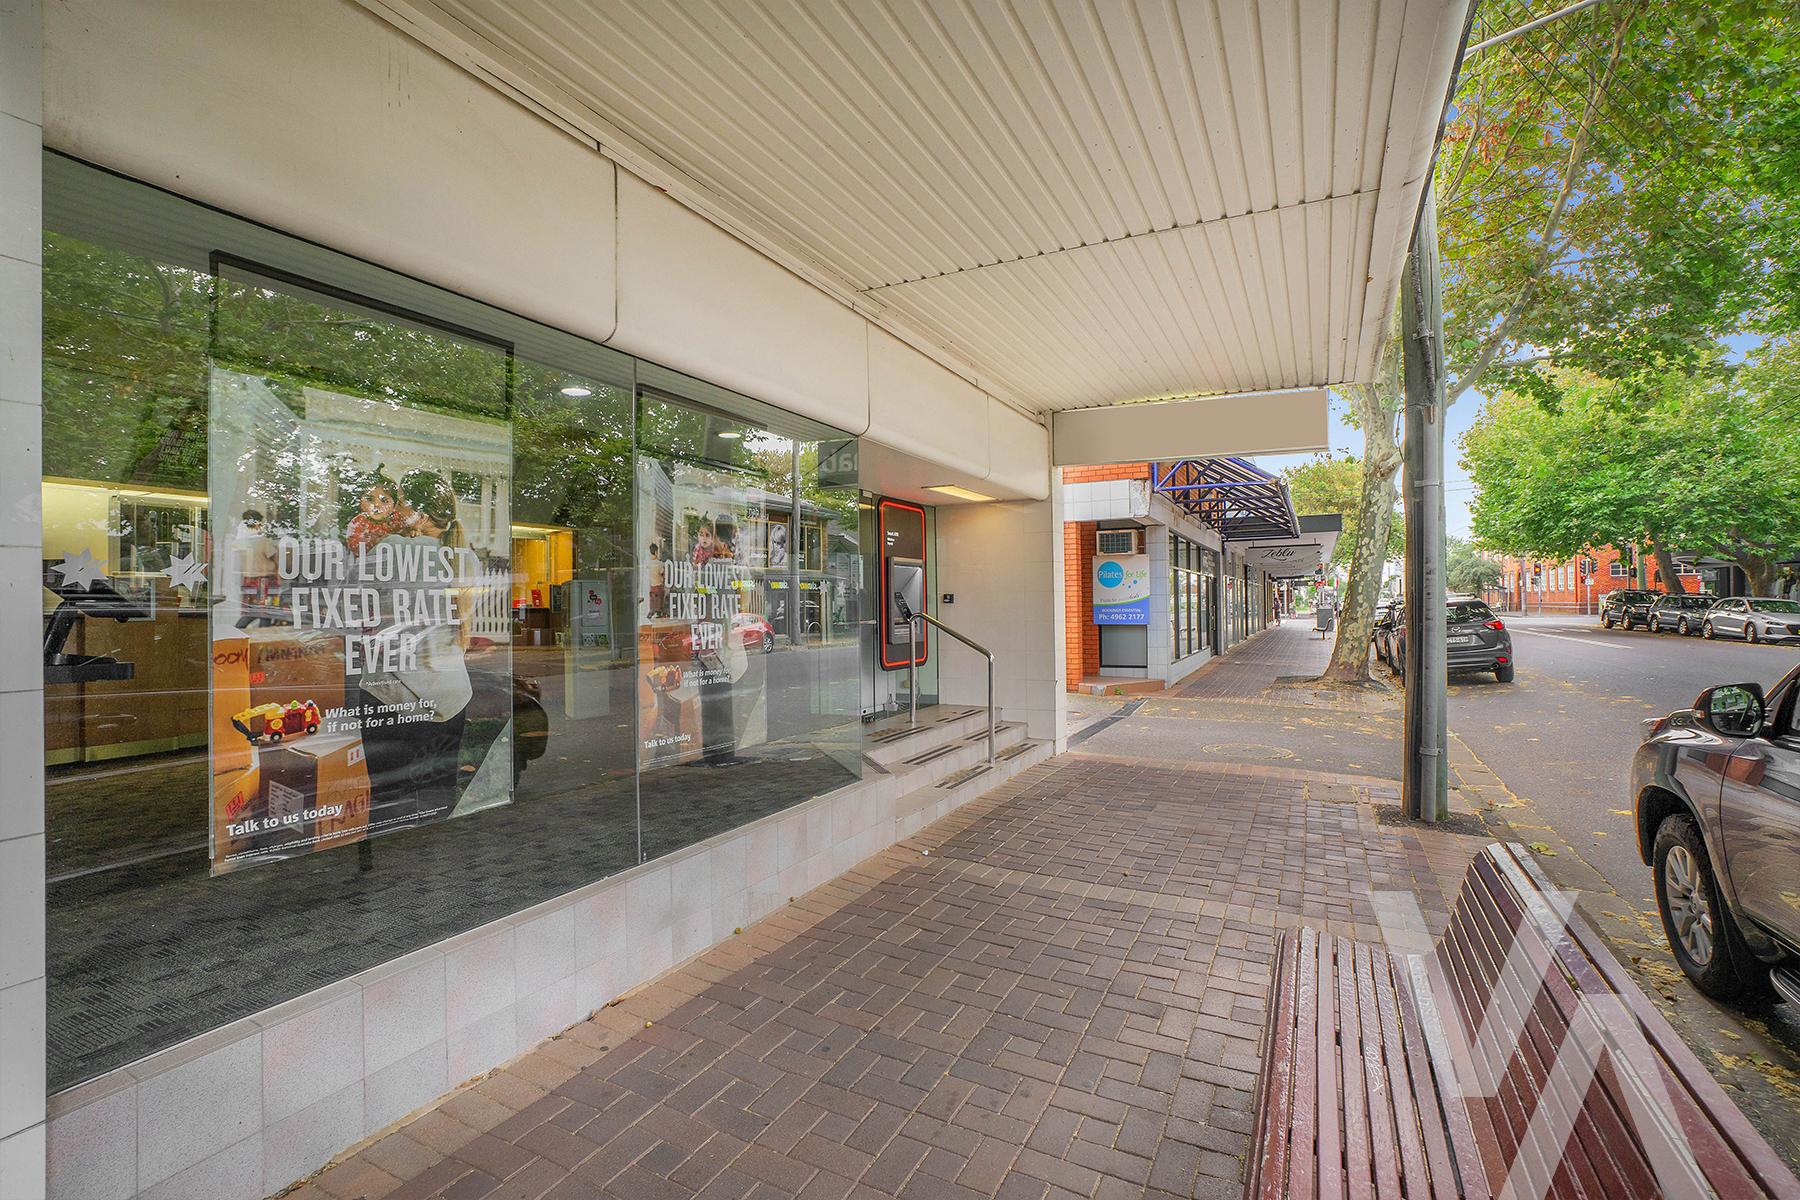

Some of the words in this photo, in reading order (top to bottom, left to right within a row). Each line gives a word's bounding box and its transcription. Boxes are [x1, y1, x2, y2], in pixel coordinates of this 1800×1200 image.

[278, 536, 344, 580] OUR
[358, 542, 470, 583] LOWEST
[664, 559, 693, 588] OUR
[1099, 570, 1123, 578] Pilates
[292, 588, 382, 630] FIXED
[393, 588, 462, 626] RATE
[670, 592, 706, 620] FIXED
[712, 593, 742, 619] RATE
[691, 624, 724, 650] EVER
[345, 634, 417, 676] EVER
[325, 706, 362, 720] What
[364, 704, 374, 715] is
[377, 701, 416, 714] money
[418, 698, 436, 709] for,
[327, 720, 338, 733] if
[340, 720, 362, 731] not
[366, 717, 384, 728] for
[386, 717, 394, 726] a
[397, 710, 435, 724] home?
[644, 739, 658, 749] Talk
[675, 733, 691, 742] today
[226, 820, 259, 836] Talk
[263, 818, 278, 829] to
[283, 813, 299, 824] us
[303, 803, 343, 822] today
